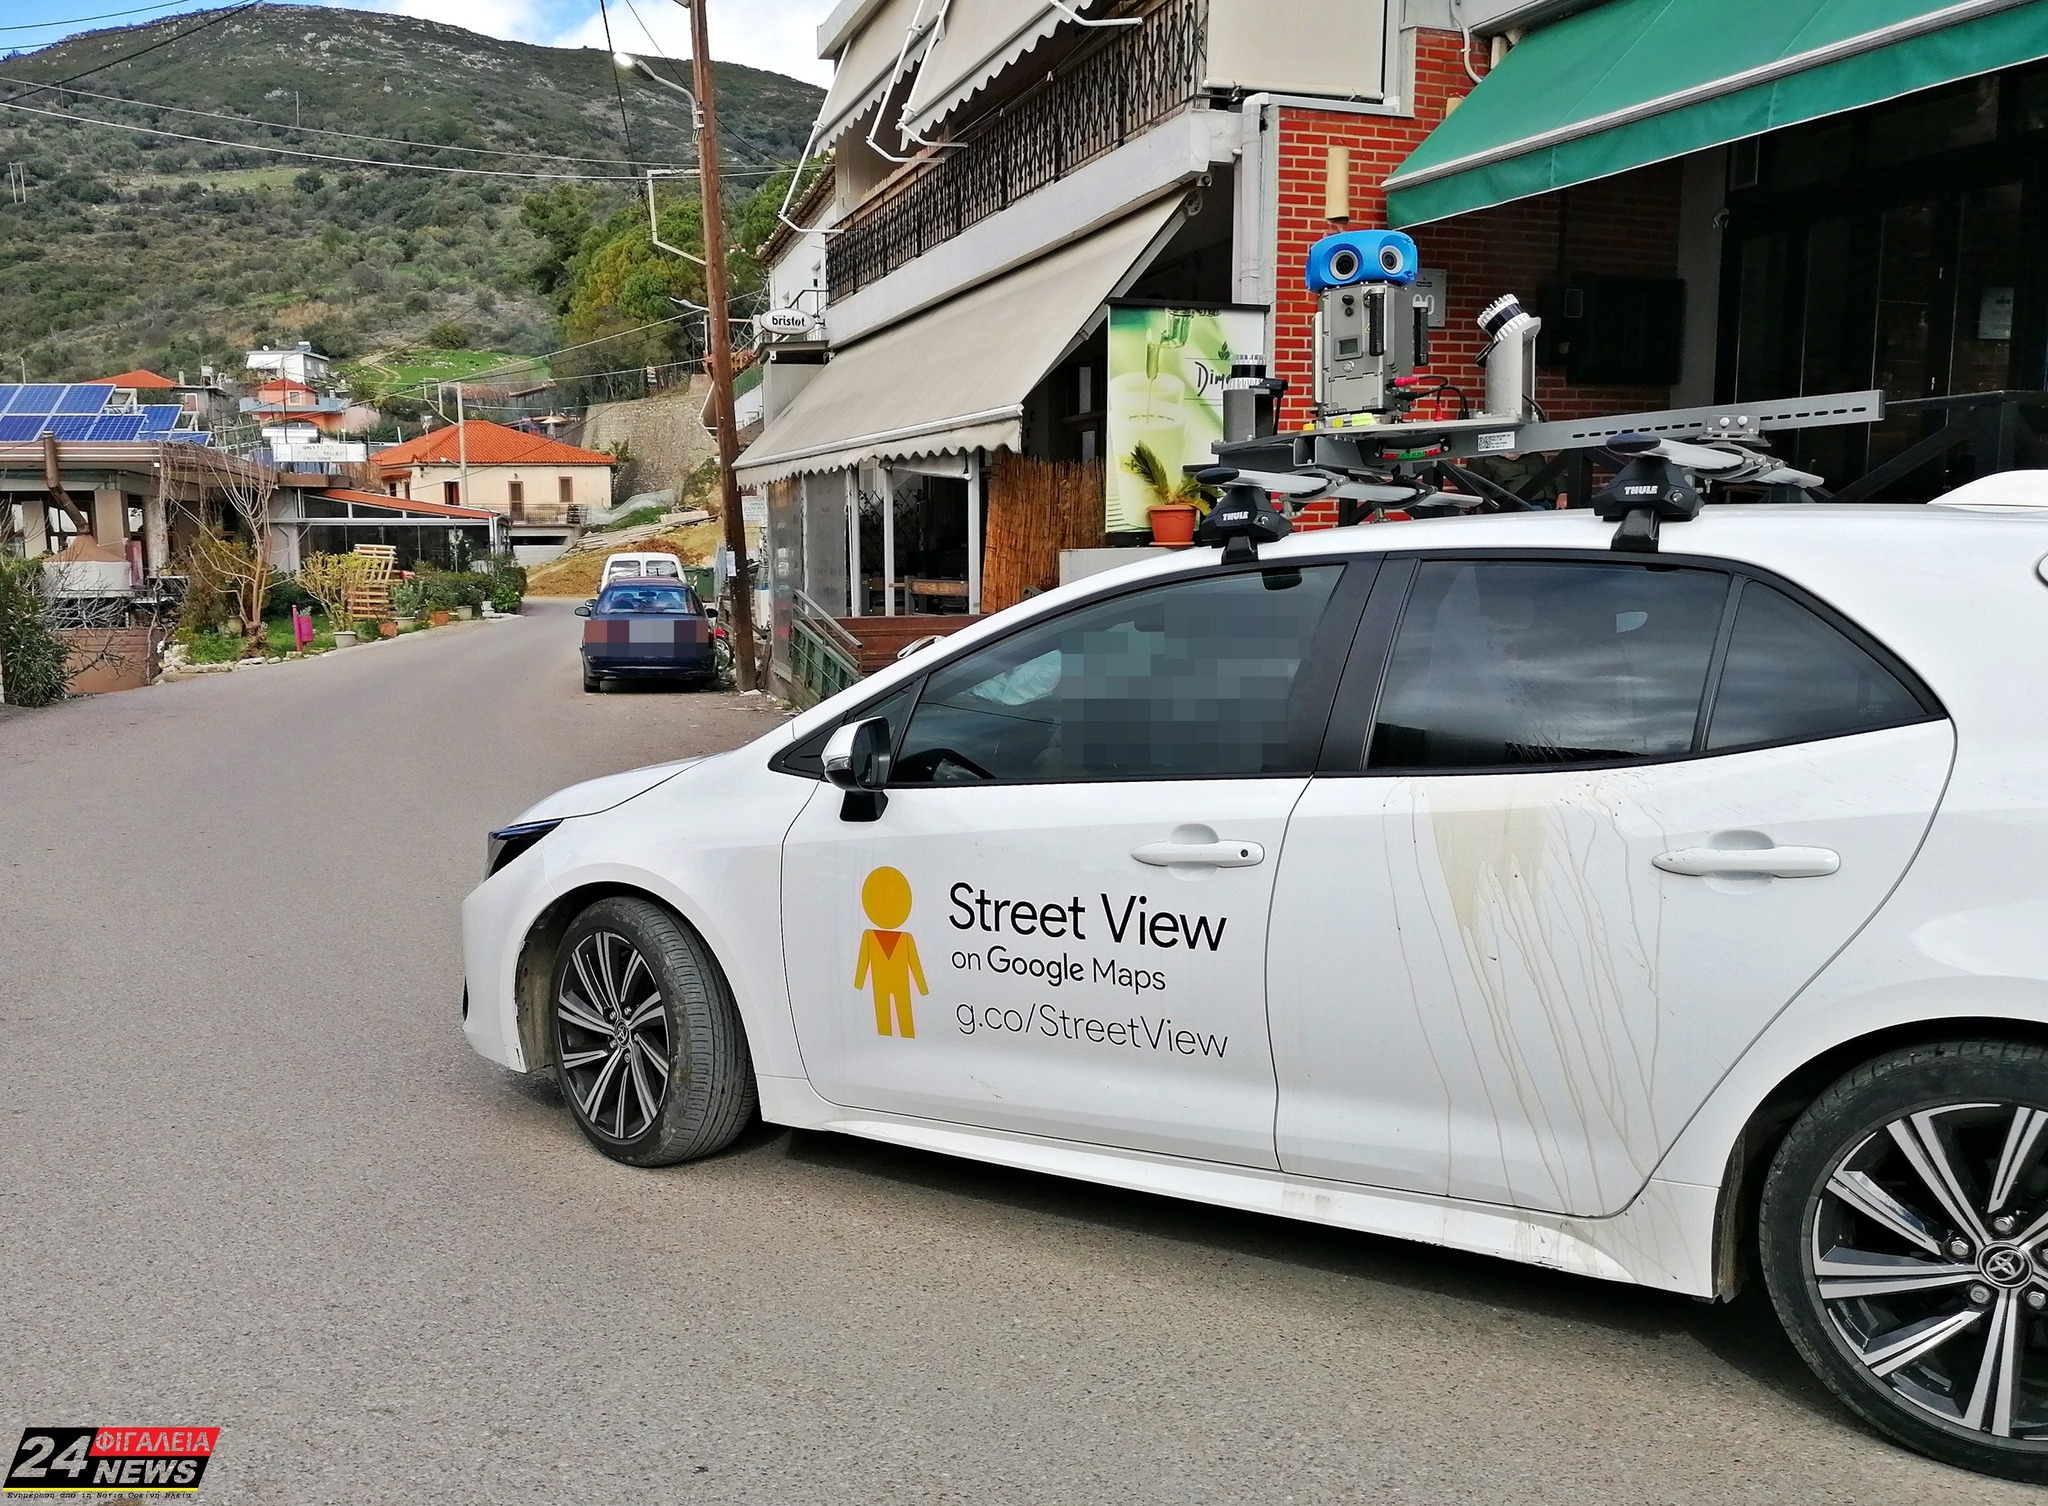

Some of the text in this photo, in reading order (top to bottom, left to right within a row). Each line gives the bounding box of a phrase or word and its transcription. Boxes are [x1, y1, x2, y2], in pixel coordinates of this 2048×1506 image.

[772, 315, 806, 327] bristot
[1624, 485, 1658, 495] THULE
[1222, 511, 1249, 521] THULE
[948, 881, 1228, 951] Street View
[951, 945, 1167, 994] on Google Maps
[955, 1003, 1229, 1059] g.co/StreetView
